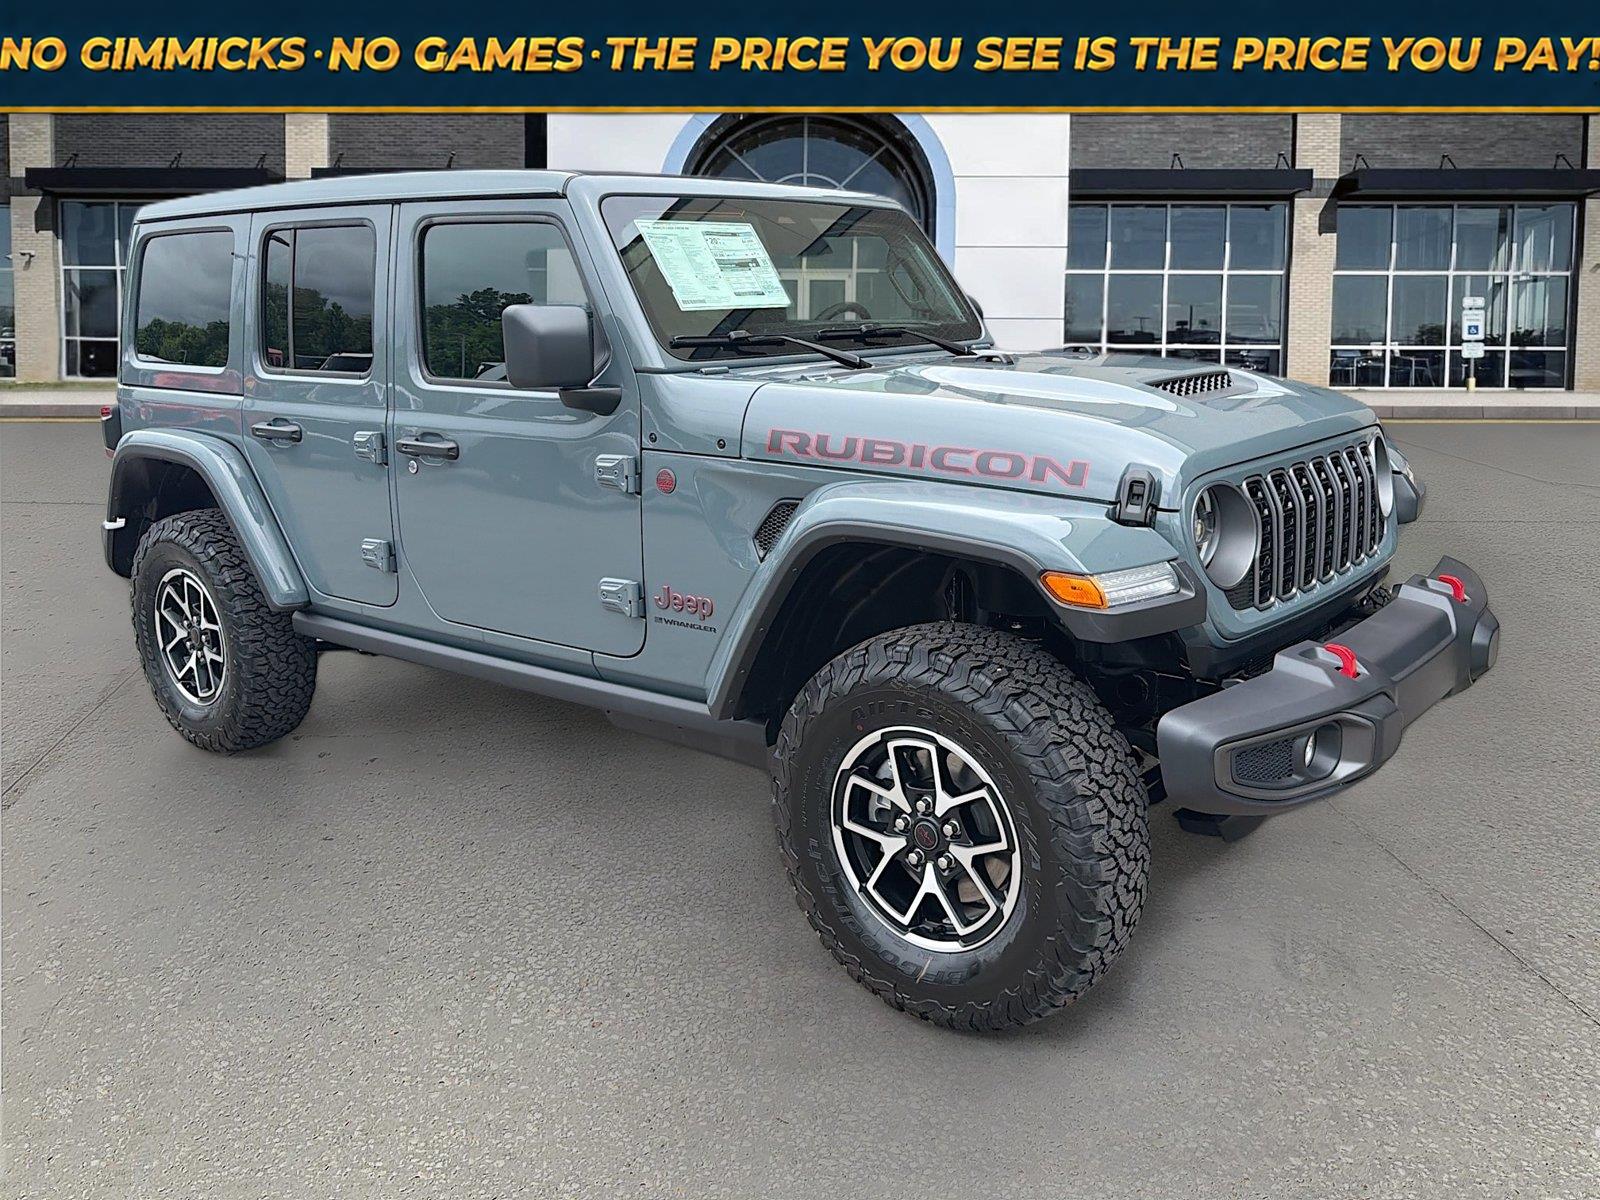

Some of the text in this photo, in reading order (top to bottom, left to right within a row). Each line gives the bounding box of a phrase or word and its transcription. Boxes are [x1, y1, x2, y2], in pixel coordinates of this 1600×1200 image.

[767, 428, 1090, 489] RUBICON
[654, 585, 714, 621] Jeep
[663, 617, 717, 634] WRANGLER
